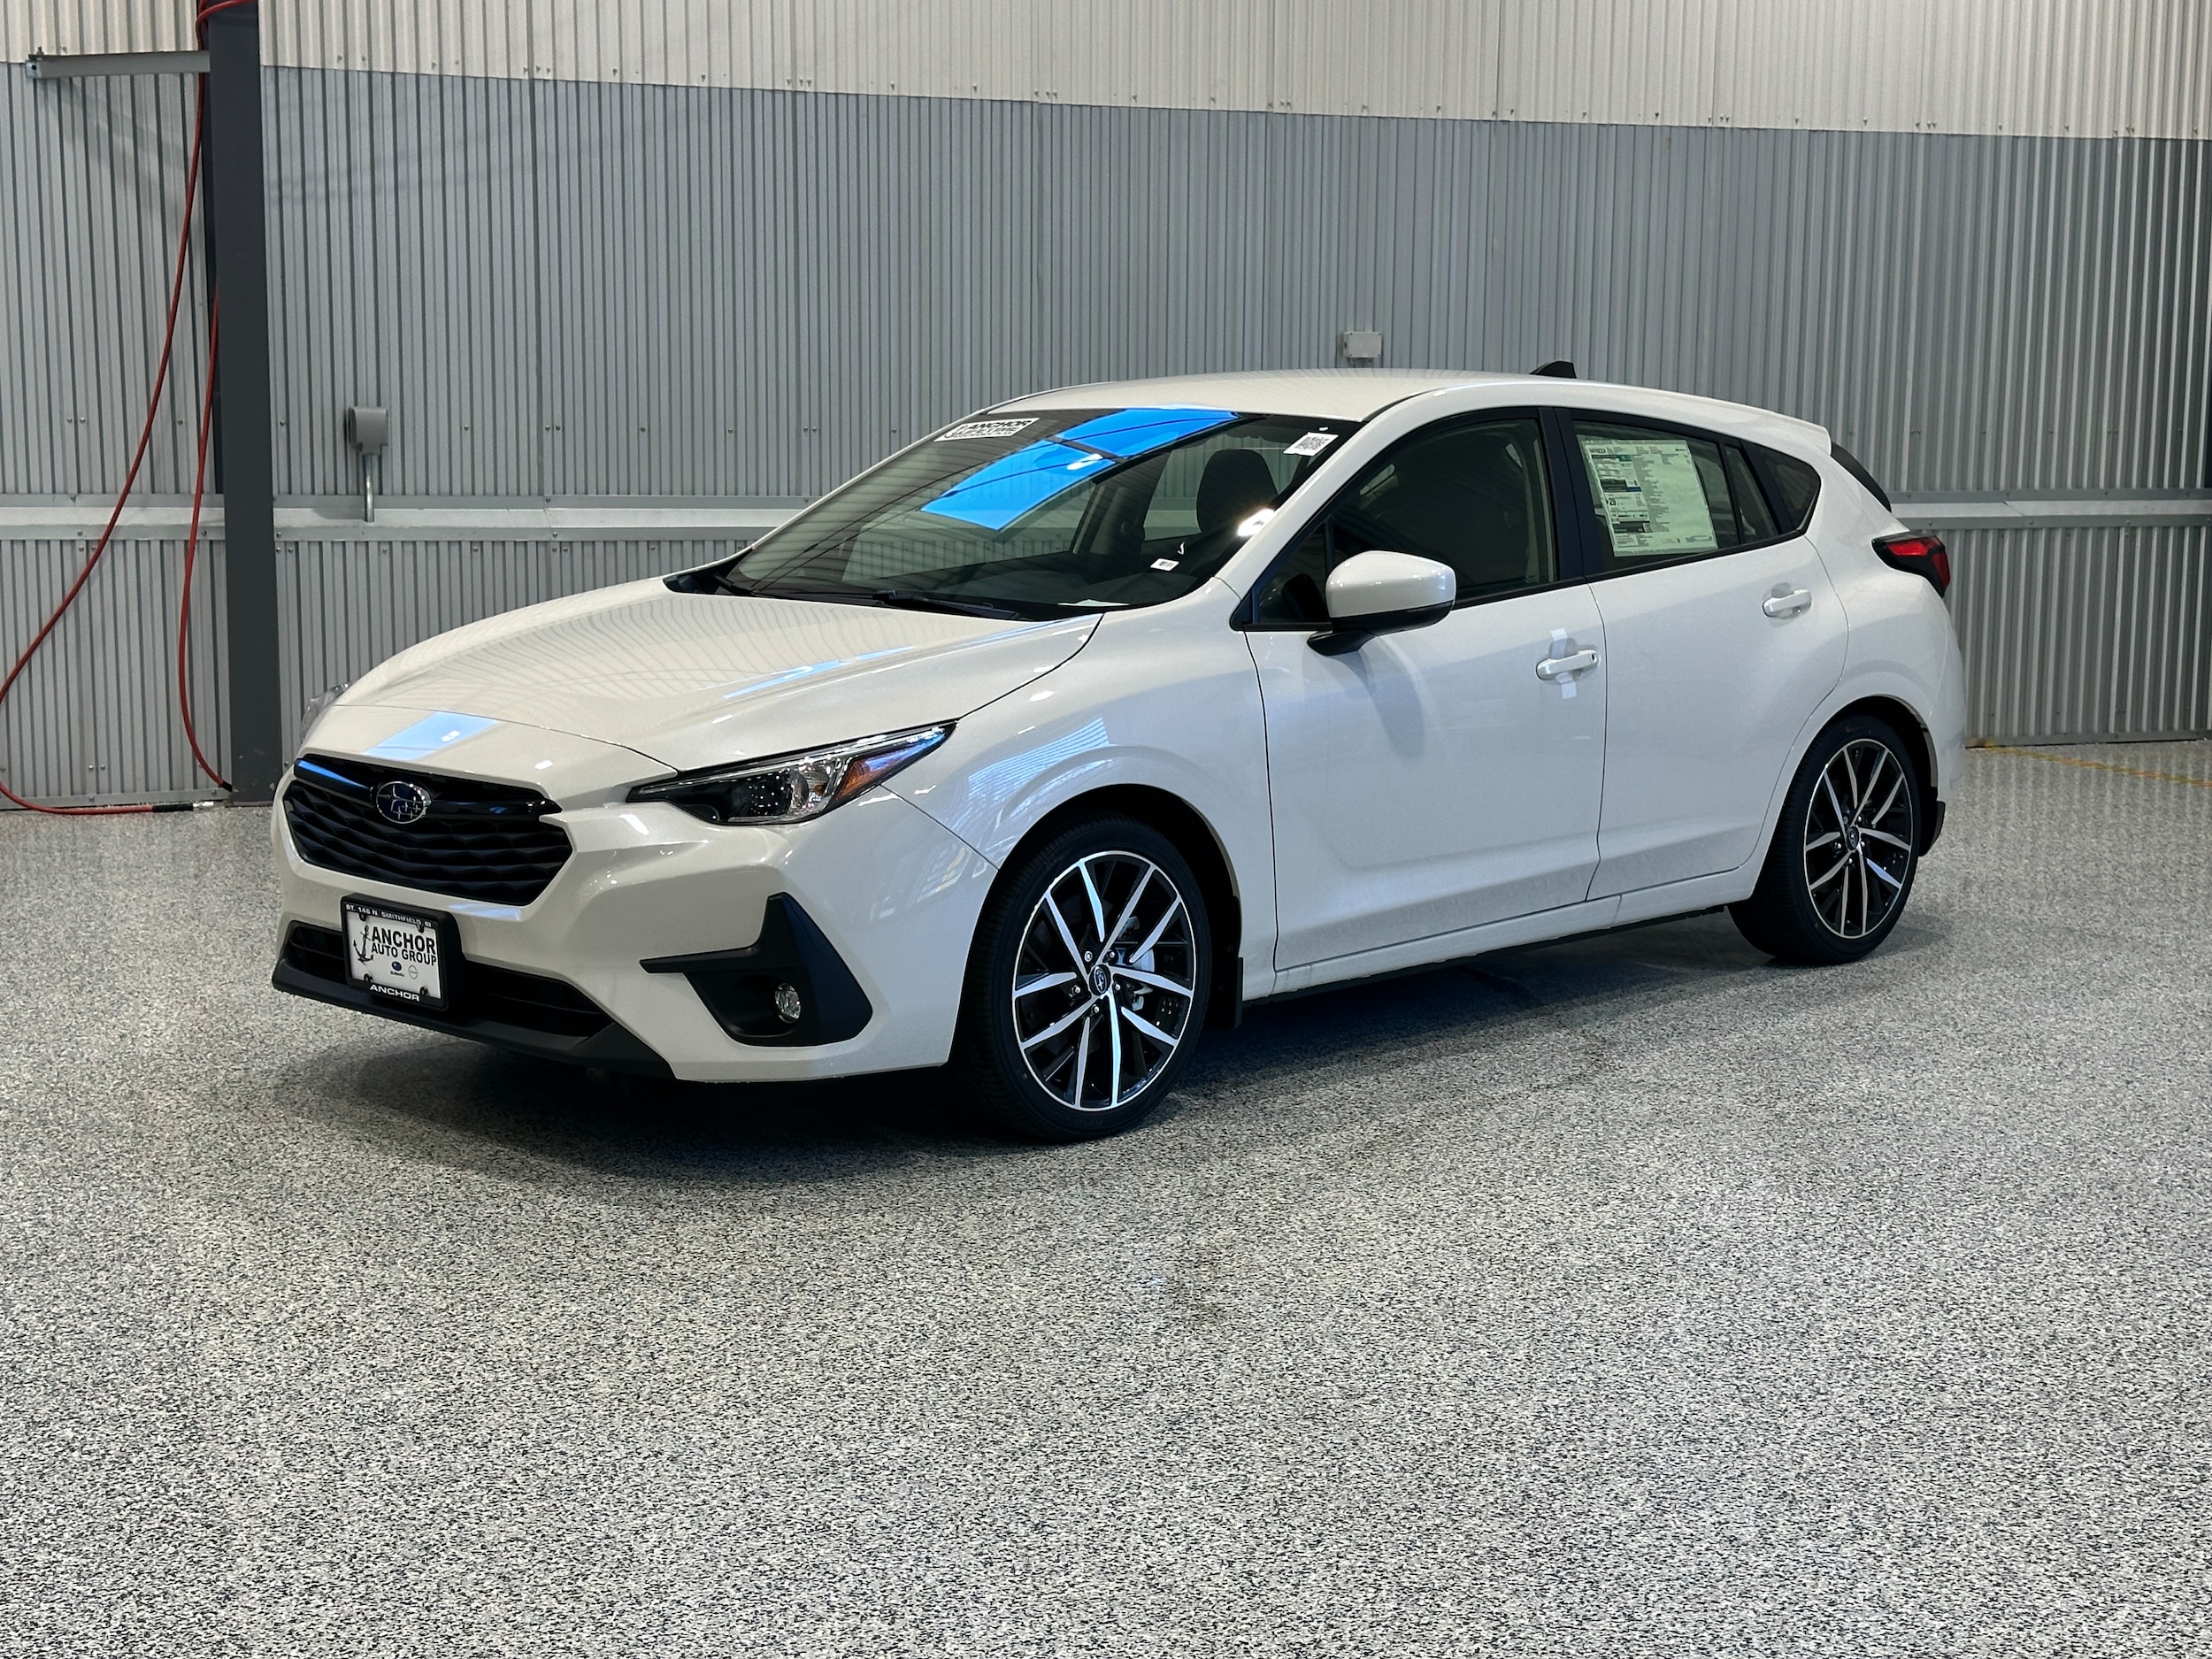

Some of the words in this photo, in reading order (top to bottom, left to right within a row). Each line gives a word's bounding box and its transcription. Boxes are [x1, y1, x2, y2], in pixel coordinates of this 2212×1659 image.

[969, 420, 1032, 429] ANCHOR
[372, 926, 436, 956] ANCHOR
[372, 942, 398, 958] AUTO
[402, 949, 436, 966] GROUP
[370, 984, 420, 1002] ANCHOR
